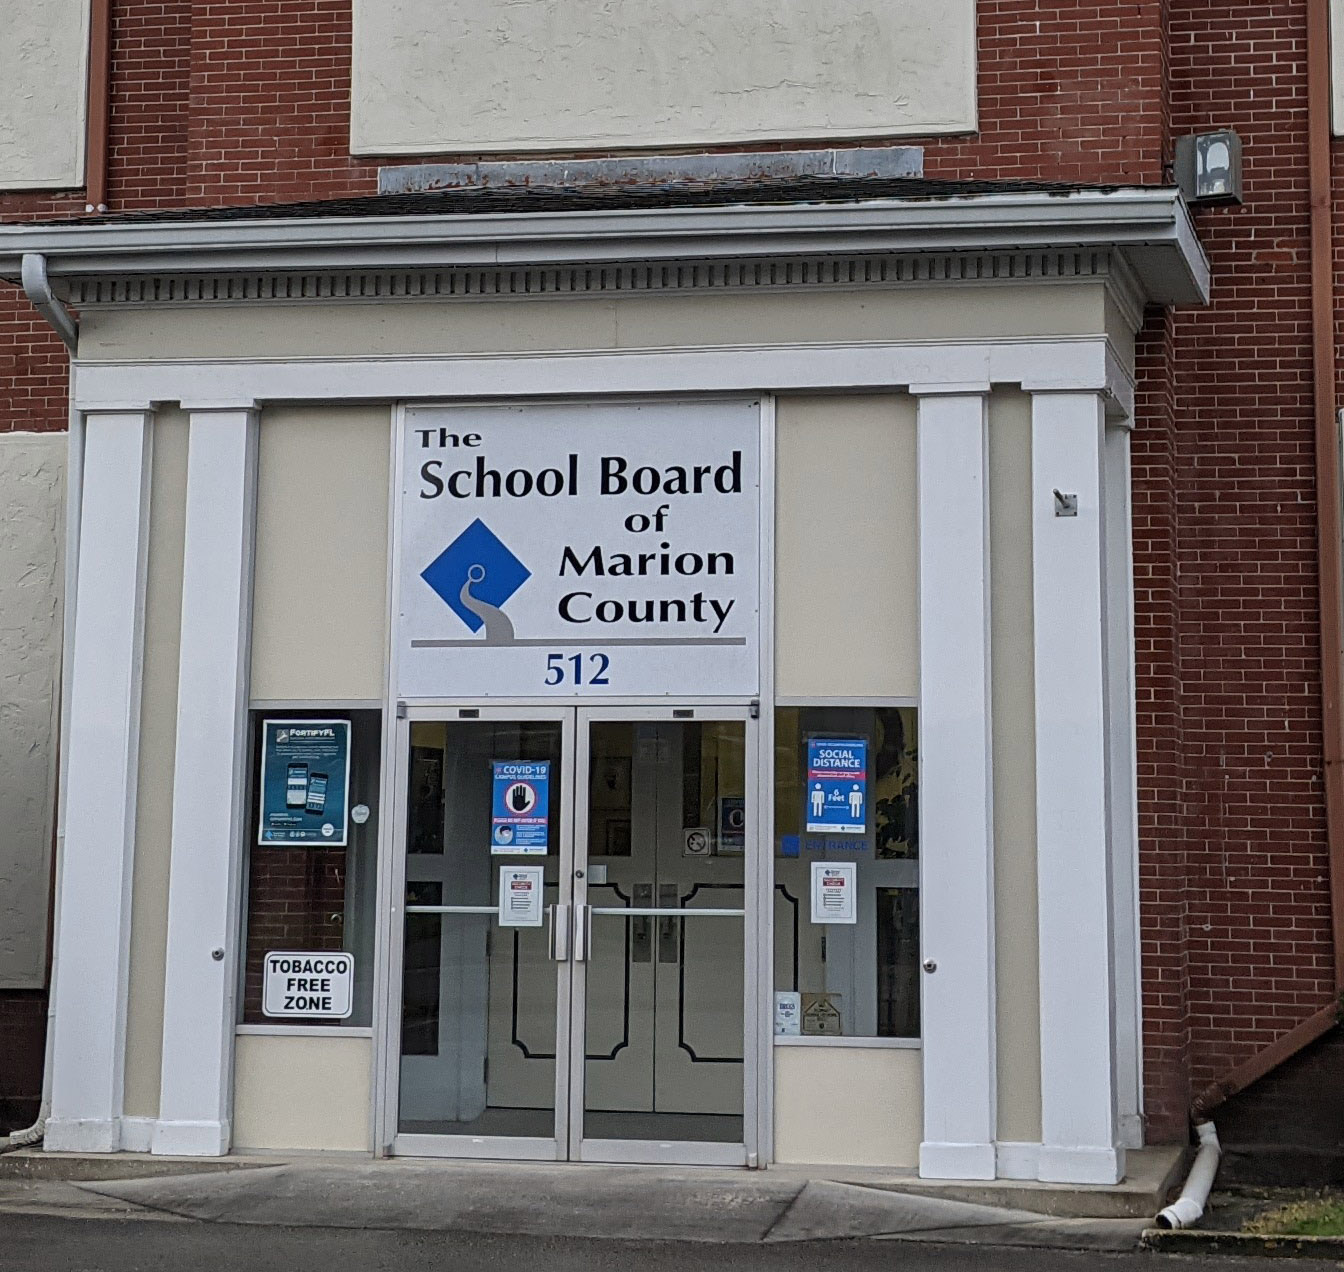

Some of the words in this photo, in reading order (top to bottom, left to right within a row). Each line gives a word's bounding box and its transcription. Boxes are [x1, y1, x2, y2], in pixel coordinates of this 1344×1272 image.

[415, 428, 482, 448] The
[420, 454, 578, 499] School
[600, 451, 742, 495] Board
[624, 504, 670, 533] of
[559, 542, 735, 577] Marion
[558, 591, 736, 634] County
[544, 653, 610, 686] 512
[819, 749, 854, 759] SOCIAL
[503, 765, 547, 774] COVID-19
[813, 758, 860, 768] DISTANCE
[827, 793, 845, 802] Feet
[806, 840, 869, 850] ENTRANCE
[270, 959, 348, 974] TOBACCO
[287, 978, 330, 992] FREE
[284, 996, 332, 1010] ZONE
